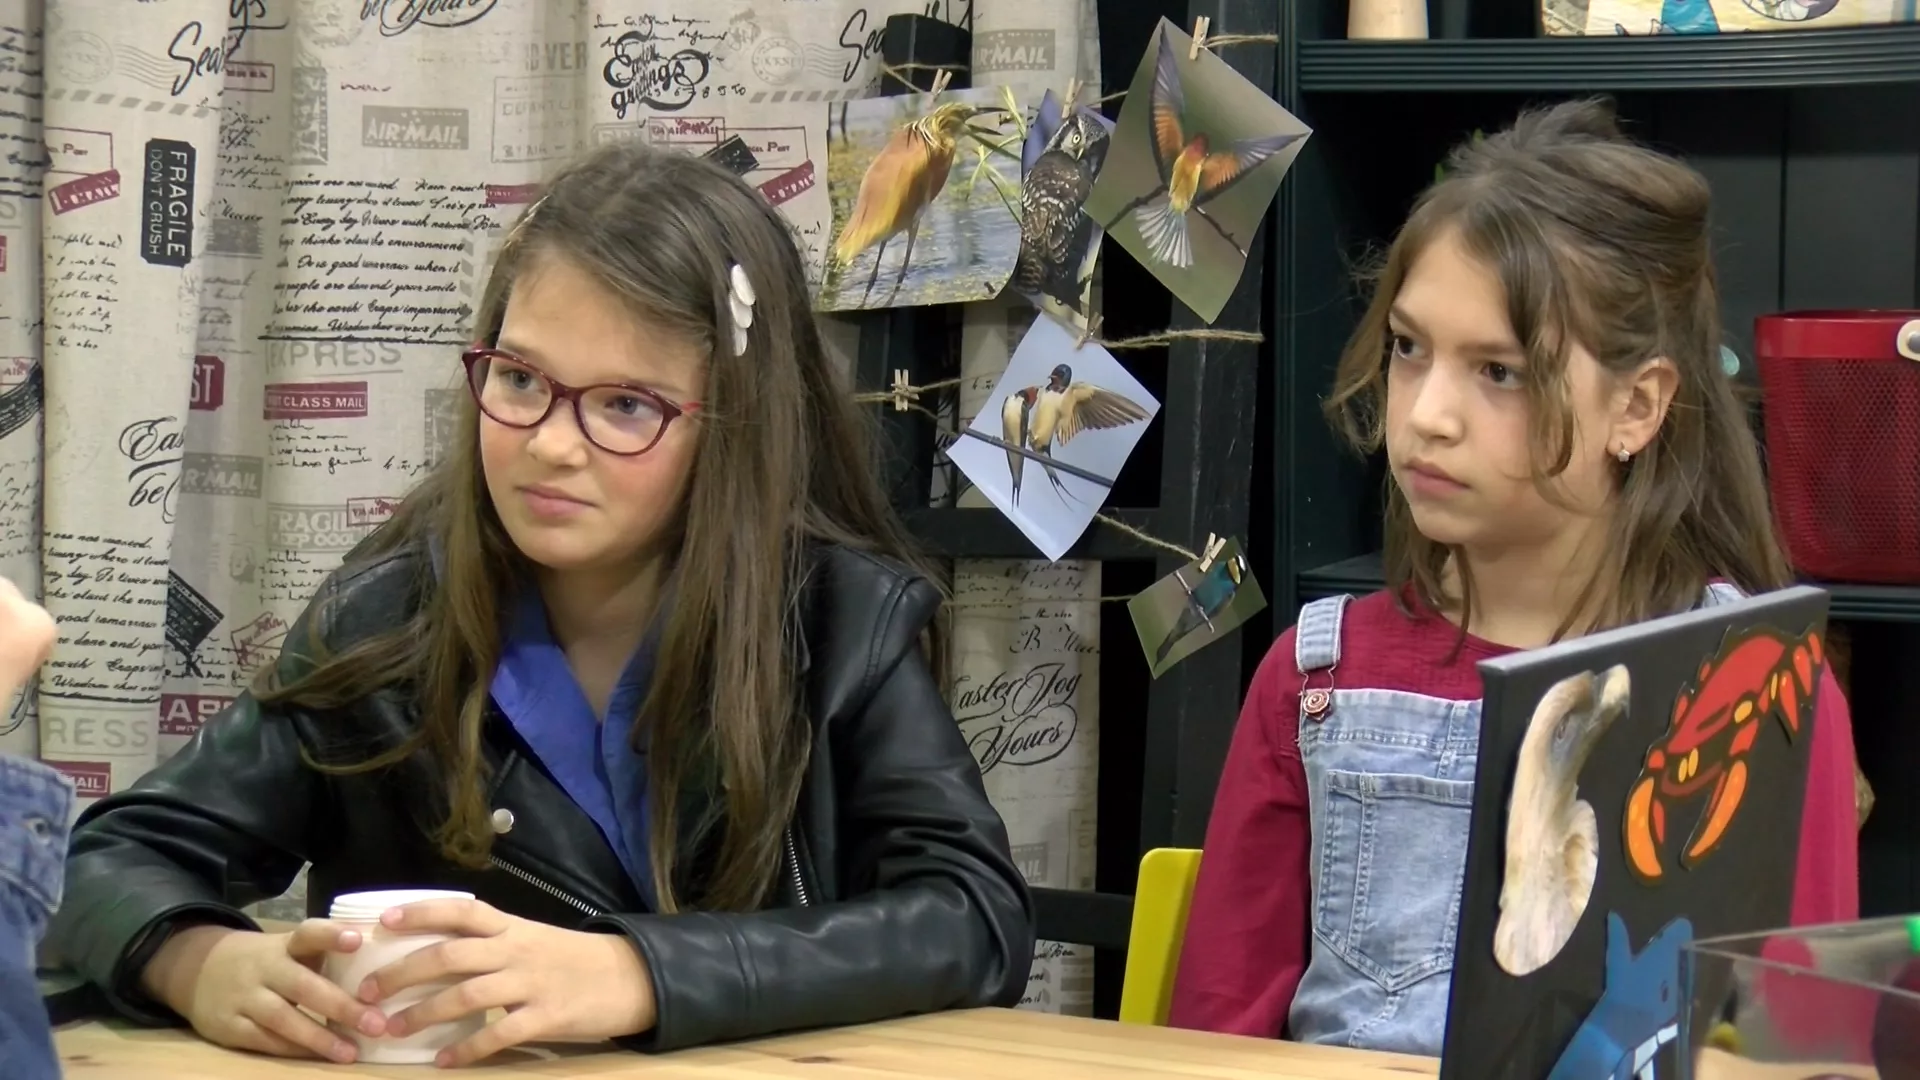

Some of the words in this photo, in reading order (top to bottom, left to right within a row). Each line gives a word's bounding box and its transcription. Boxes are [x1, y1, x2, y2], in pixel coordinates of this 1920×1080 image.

[149, 201, 163, 255] CRUSH
[166, 151, 188, 257] FRAGILE
[283, 395, 332, 408] CLASS
[335, 395, 364, 408] MAIL
[1012, 662, 1083, 723] Joy
[968, 720, 1064, 776] Yours
